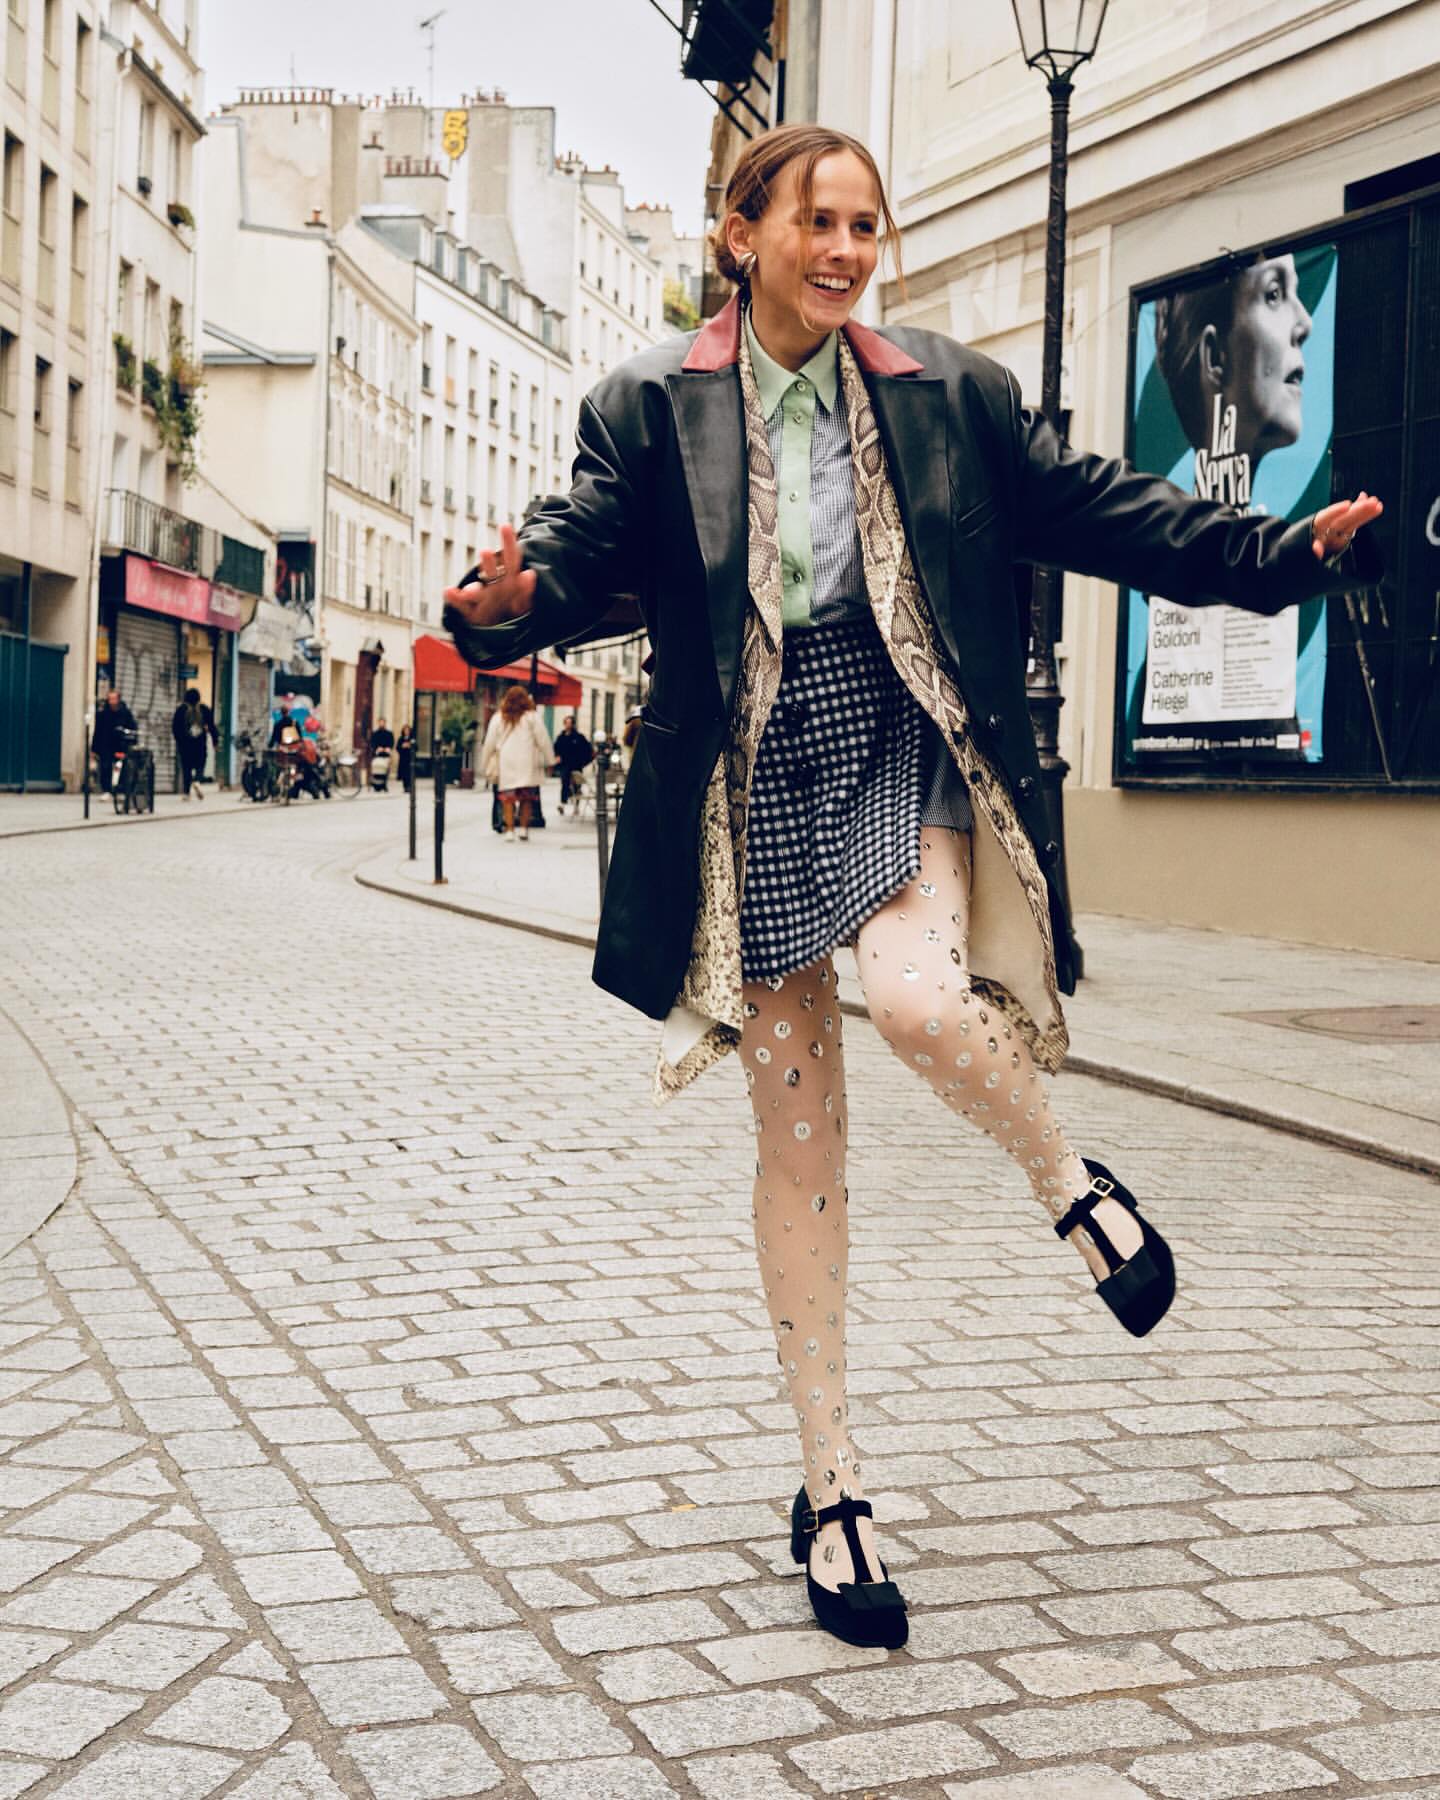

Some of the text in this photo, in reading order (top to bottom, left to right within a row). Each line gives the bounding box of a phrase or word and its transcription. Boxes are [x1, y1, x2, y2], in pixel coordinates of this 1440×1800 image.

[1211, 392, 1237, 458] La
[1194, 448, 1250, 506] Serva
[1153, 626, 1201, 649] Goldoni
[1151, 667, 1215, 689] Catherine
[1150, 691, 1188, 714] Hiegel
